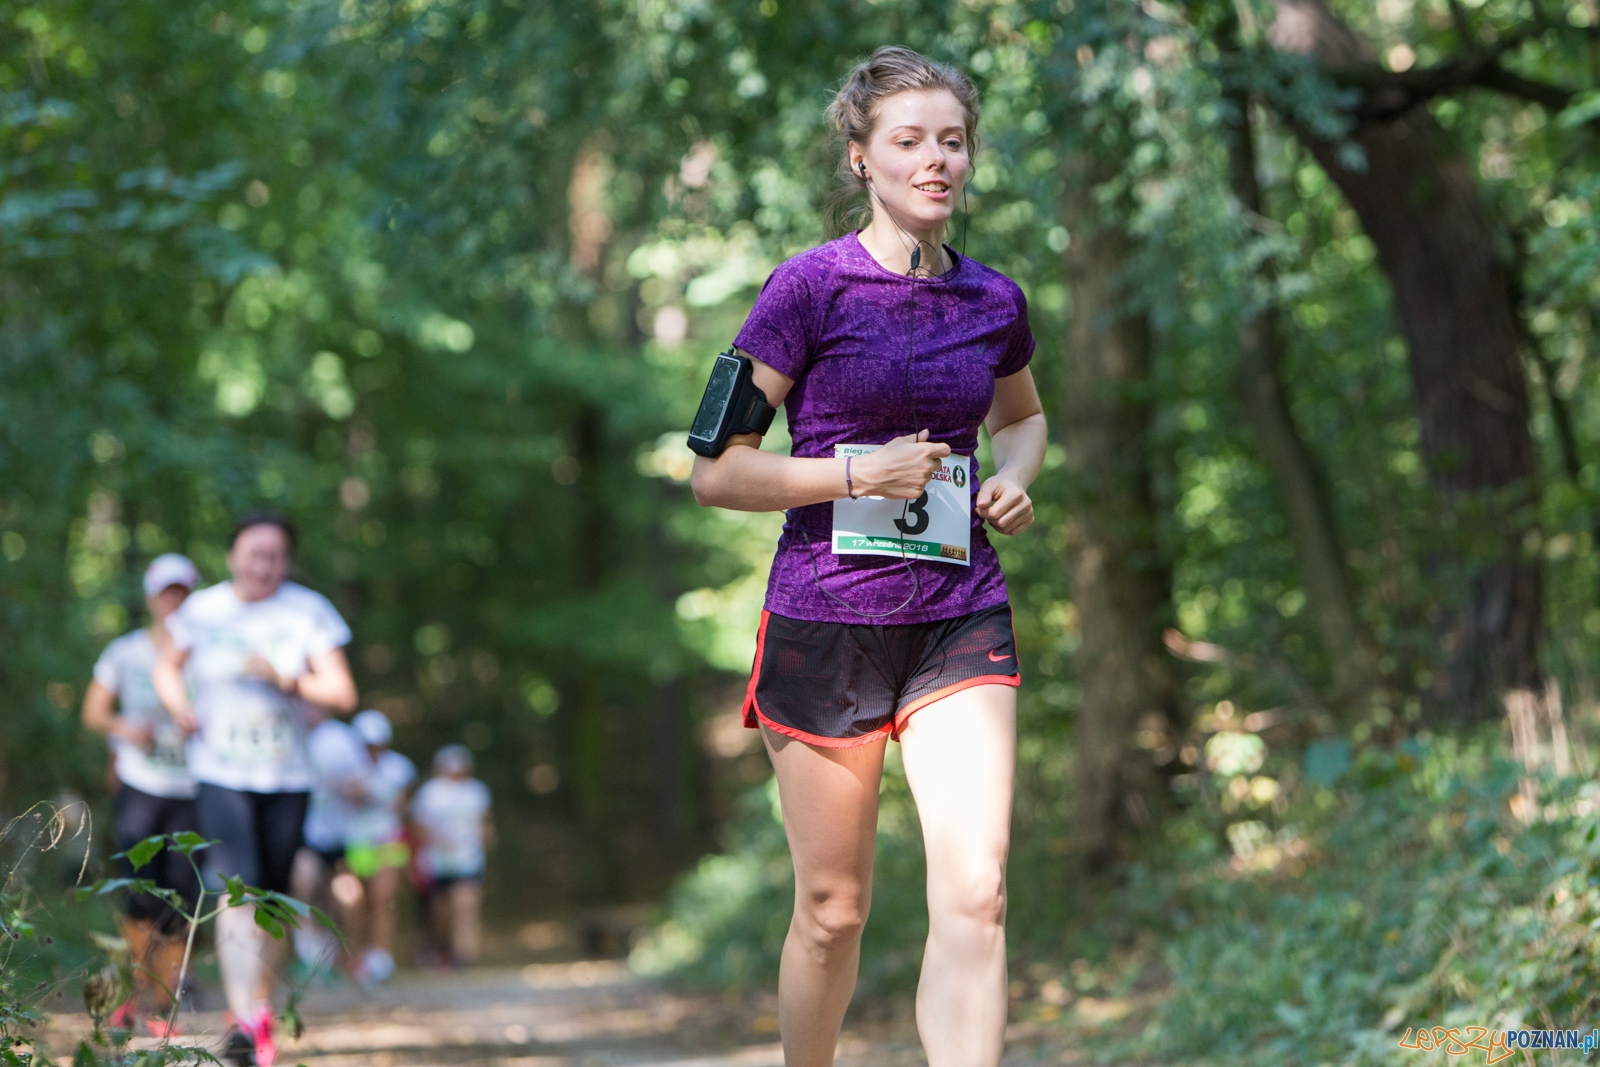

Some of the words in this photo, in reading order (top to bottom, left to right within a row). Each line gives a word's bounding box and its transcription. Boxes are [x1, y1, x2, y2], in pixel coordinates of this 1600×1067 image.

[843, 447, 863, 456] Bieg
[893, 489, 930, 535] 3
[851, 539, 865, 547] 17
[903, 542, 929, 552] 2016
